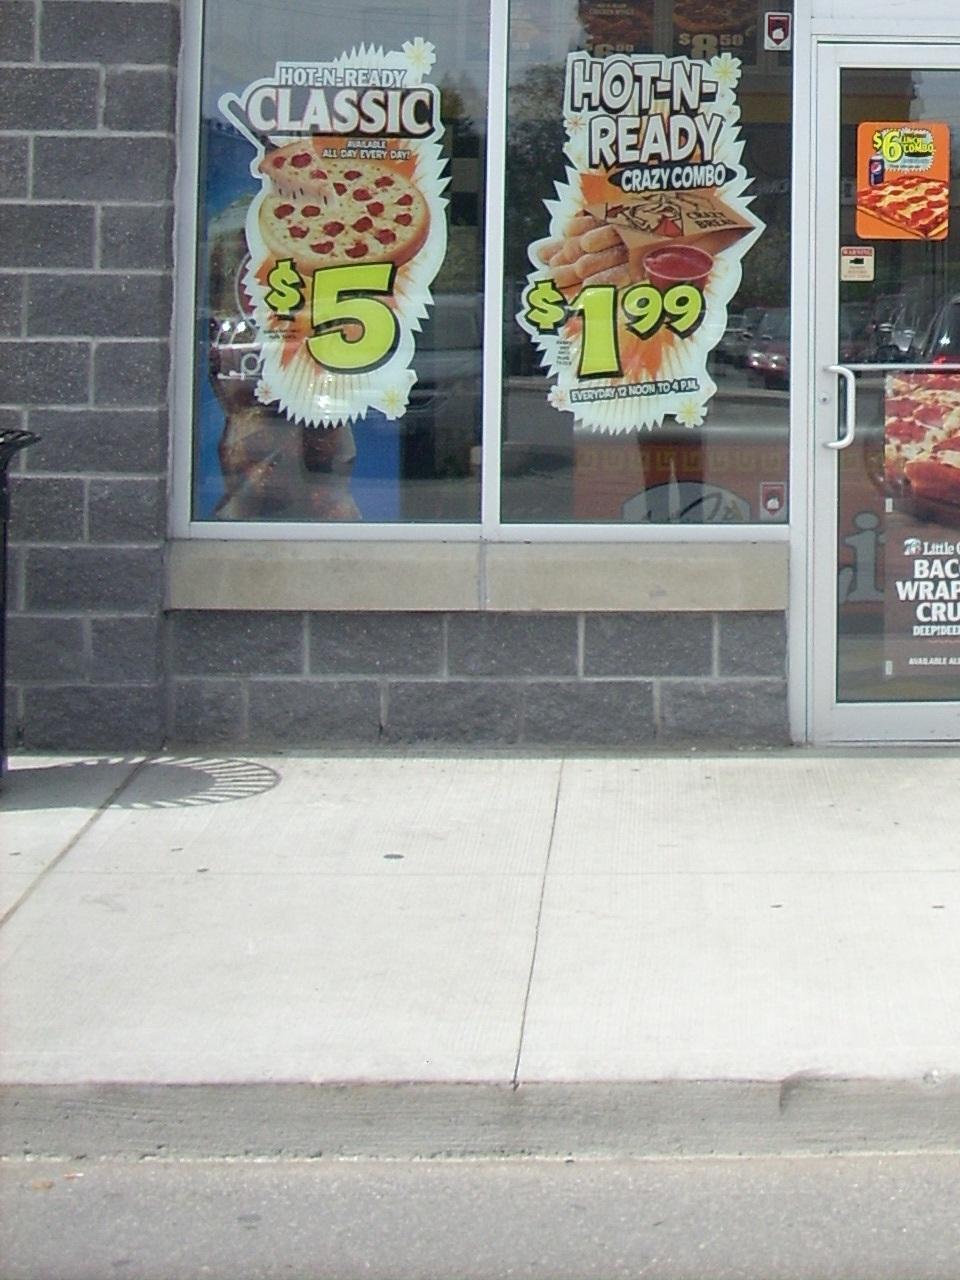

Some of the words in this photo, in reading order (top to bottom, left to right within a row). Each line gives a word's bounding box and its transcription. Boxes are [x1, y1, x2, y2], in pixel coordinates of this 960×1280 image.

[279, 66, 407, 88] HOT-N-READY
[246, 86, 434, 135] CLASSIC
[588, 113, 724, 166] READY
[322, 149, 338, 159] ALL
[341, 149, 358, 159] DAY
[360, 149, 388, 160] EVERY
[620, 167, 669, 192] CRAZY
[671, 163, 727, 190] COMBO
[264, 257, 402, 375] $5
[570, 388, 617, 402] EVERYDAY
[628, 384, 656, 397] NOON
[657, 383, 671, 393] TO
[672, 381, 680, 391] 4
[922, 541, 955, 556] Little
[908, 656, 947, 666] AVAILABLE
